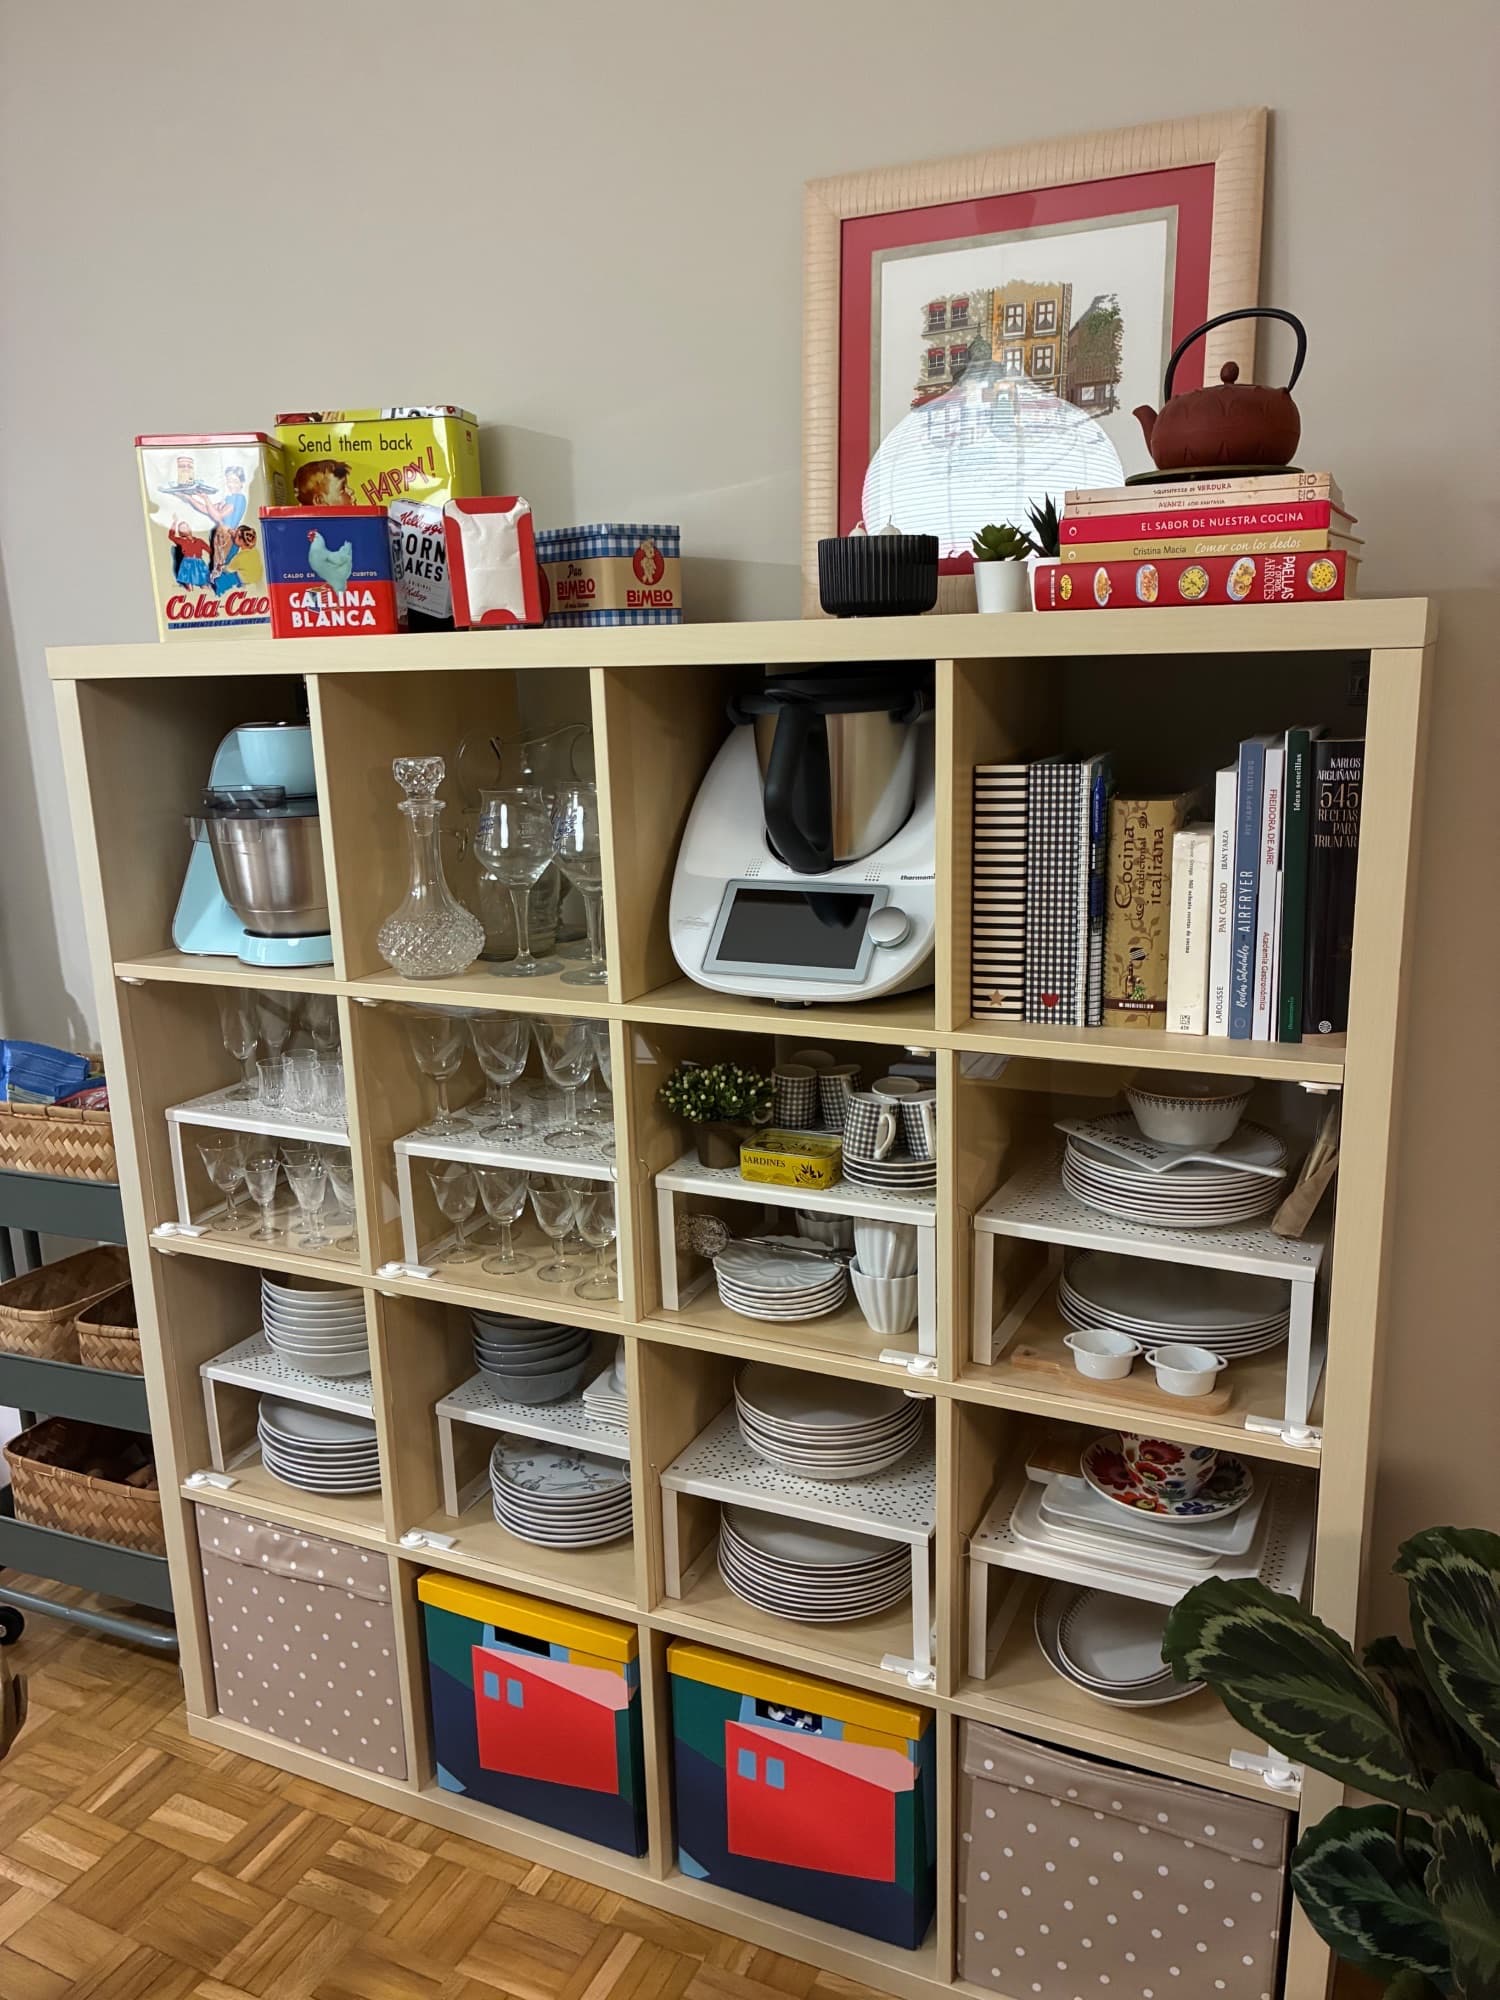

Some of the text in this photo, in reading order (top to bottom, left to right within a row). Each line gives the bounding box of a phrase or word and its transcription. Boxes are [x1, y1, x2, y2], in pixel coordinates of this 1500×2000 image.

[298, 433, 413, 453] Send them back
[361, 446, 435, 506] HAPPY!
[1197, 482, 1232, 491] VERDURA
[1158, 500, 1185, 508] AVANZI
[1141, 512, 1304, 532] EL SABOR DE NUESTRA COCINA
[1133, 546, 1162, 556] Cristina
[1195, 536, 1302, 554] Comer con los dedos
[1263, 557, 1276, 600] ARROCES
[1281, 556, 1296, 600] PAELLAS
[166, 591, 270, 620] Cola-Cao
[289, 590, 376, 608] GALLINA
[291, 610, 377, 628] BLANCA
[1330, 757, 1361, 769] KARLOS
[1293, 753, 1302, 811] Ideas sencillas
[1317, 769, 1360, 781] ARGUIÑANO
[1320, 783, 1359, 809] 545
[1318, 808, 1358, 821] RECETAS
[1266, 789, 1277, 865] FREIDORA DE AIRE
[1333, 822, 1358, 835] PARA
[1313, 834, 1357, 848] TRIUNFAR
[1114, 825, 1135, 908] Cocina
[1136, 837, 1147, 895] tradicional
[1146, 827, 1164, 905] italiana
[1219, 882, 1228, 915] CASERO
[1238, 870, 1253, 933] AIRFRYER
[1218, 917, 1227, 933] PAN
[1261, 931, 1270, 965] Academia
[743, 1155, 786, 1168] SARDINES
